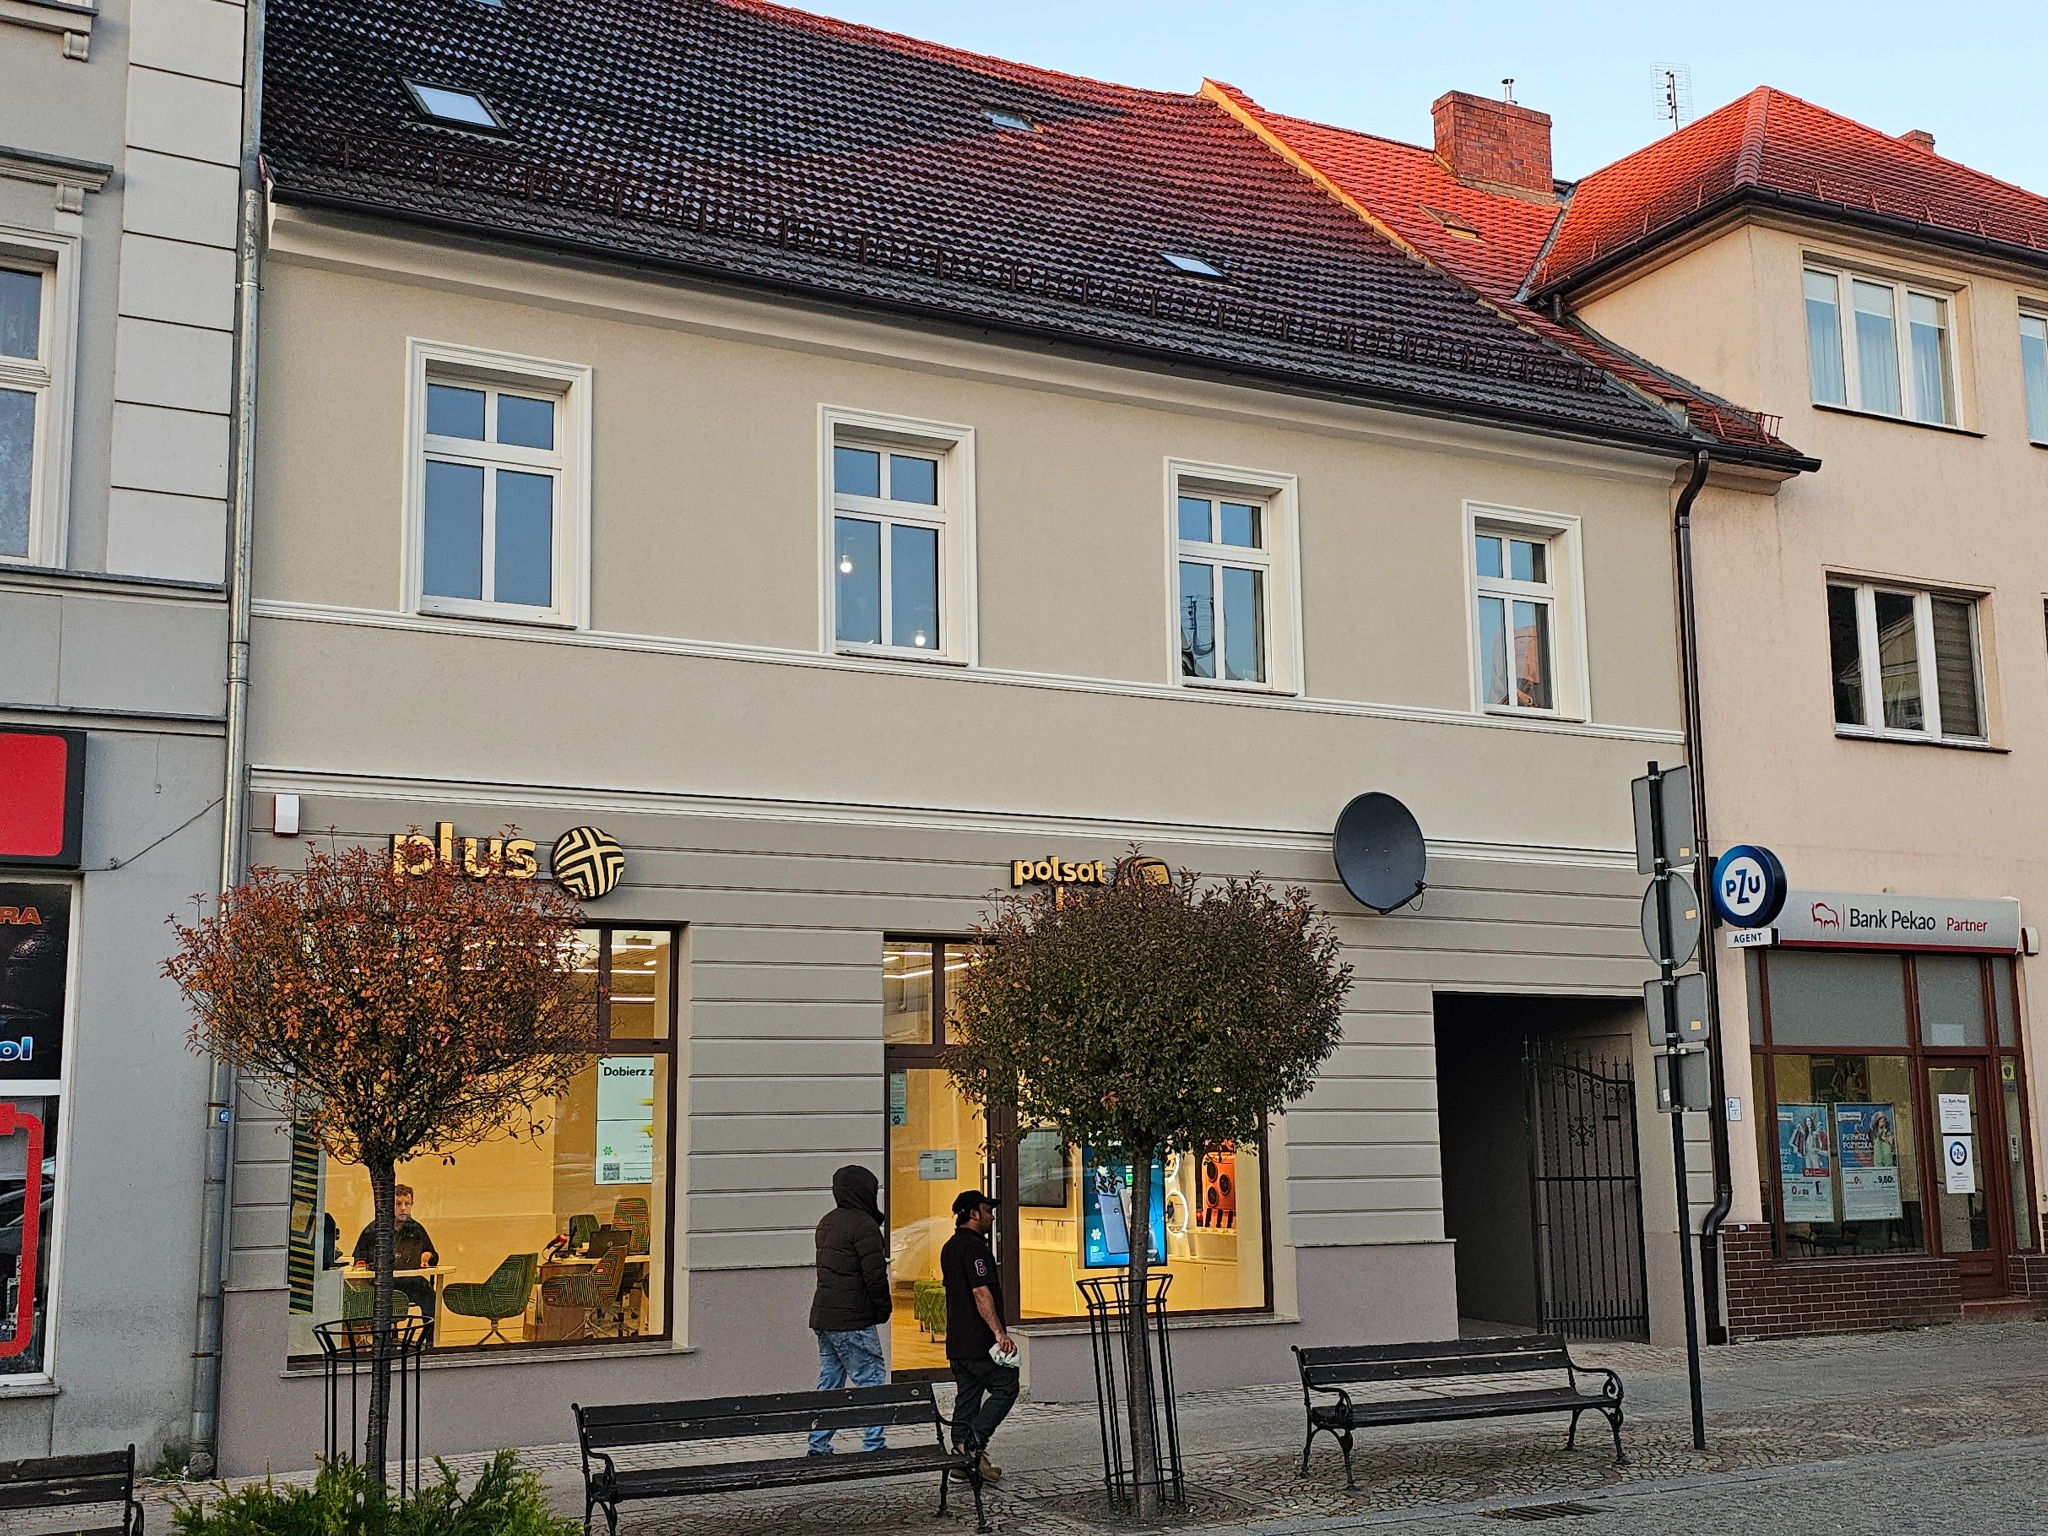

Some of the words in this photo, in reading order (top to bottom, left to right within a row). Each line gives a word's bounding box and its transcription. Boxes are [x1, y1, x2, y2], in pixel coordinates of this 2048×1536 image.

[391, 821, 538, 882] plus
[1012, 855, 1108, 888] polsat
[1725, 868, 1761, 905] PZU
[1849, 907, 1888, 930] Bank
[1891, 909, 1937, 931] Pekao
[1946, 916, 1988, 933] Partner
[1733, 931, 1763, 944] AGENT
[603, 1066, 646, 1077] Dobierz
